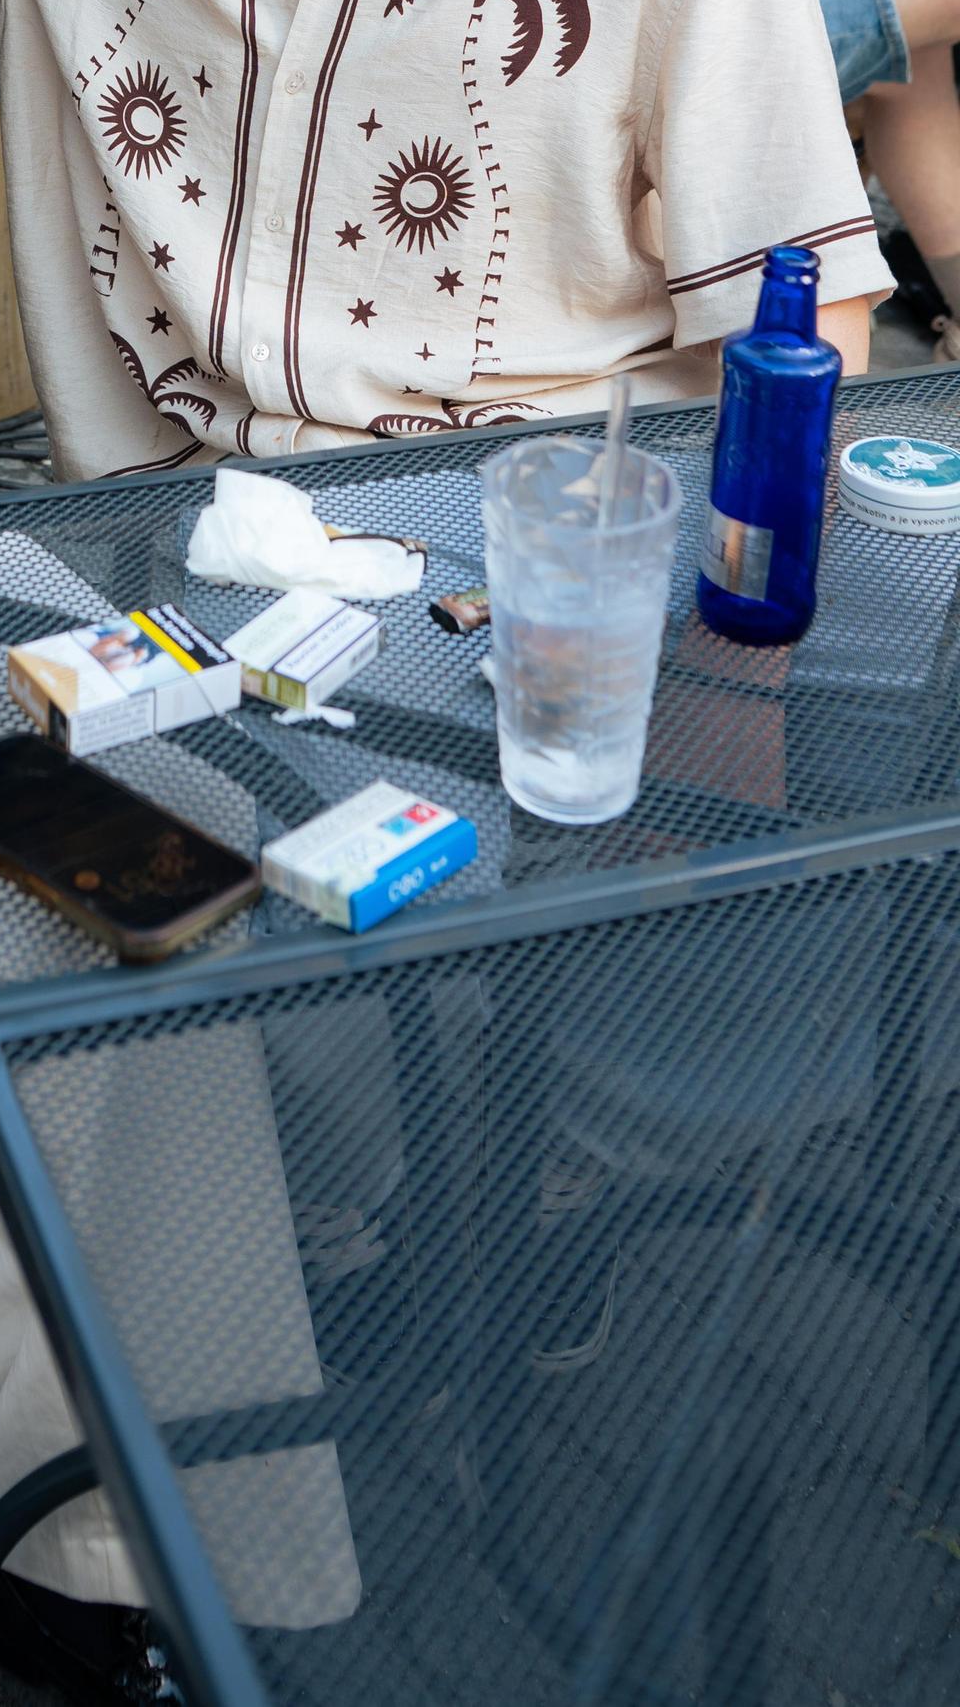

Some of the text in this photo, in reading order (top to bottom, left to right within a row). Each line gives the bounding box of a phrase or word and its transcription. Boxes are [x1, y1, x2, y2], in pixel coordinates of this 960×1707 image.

[857, 504, 887, 520] nikotin
[899, 515, 908, 525] je
[911, 517, 945, 527] vysoce
